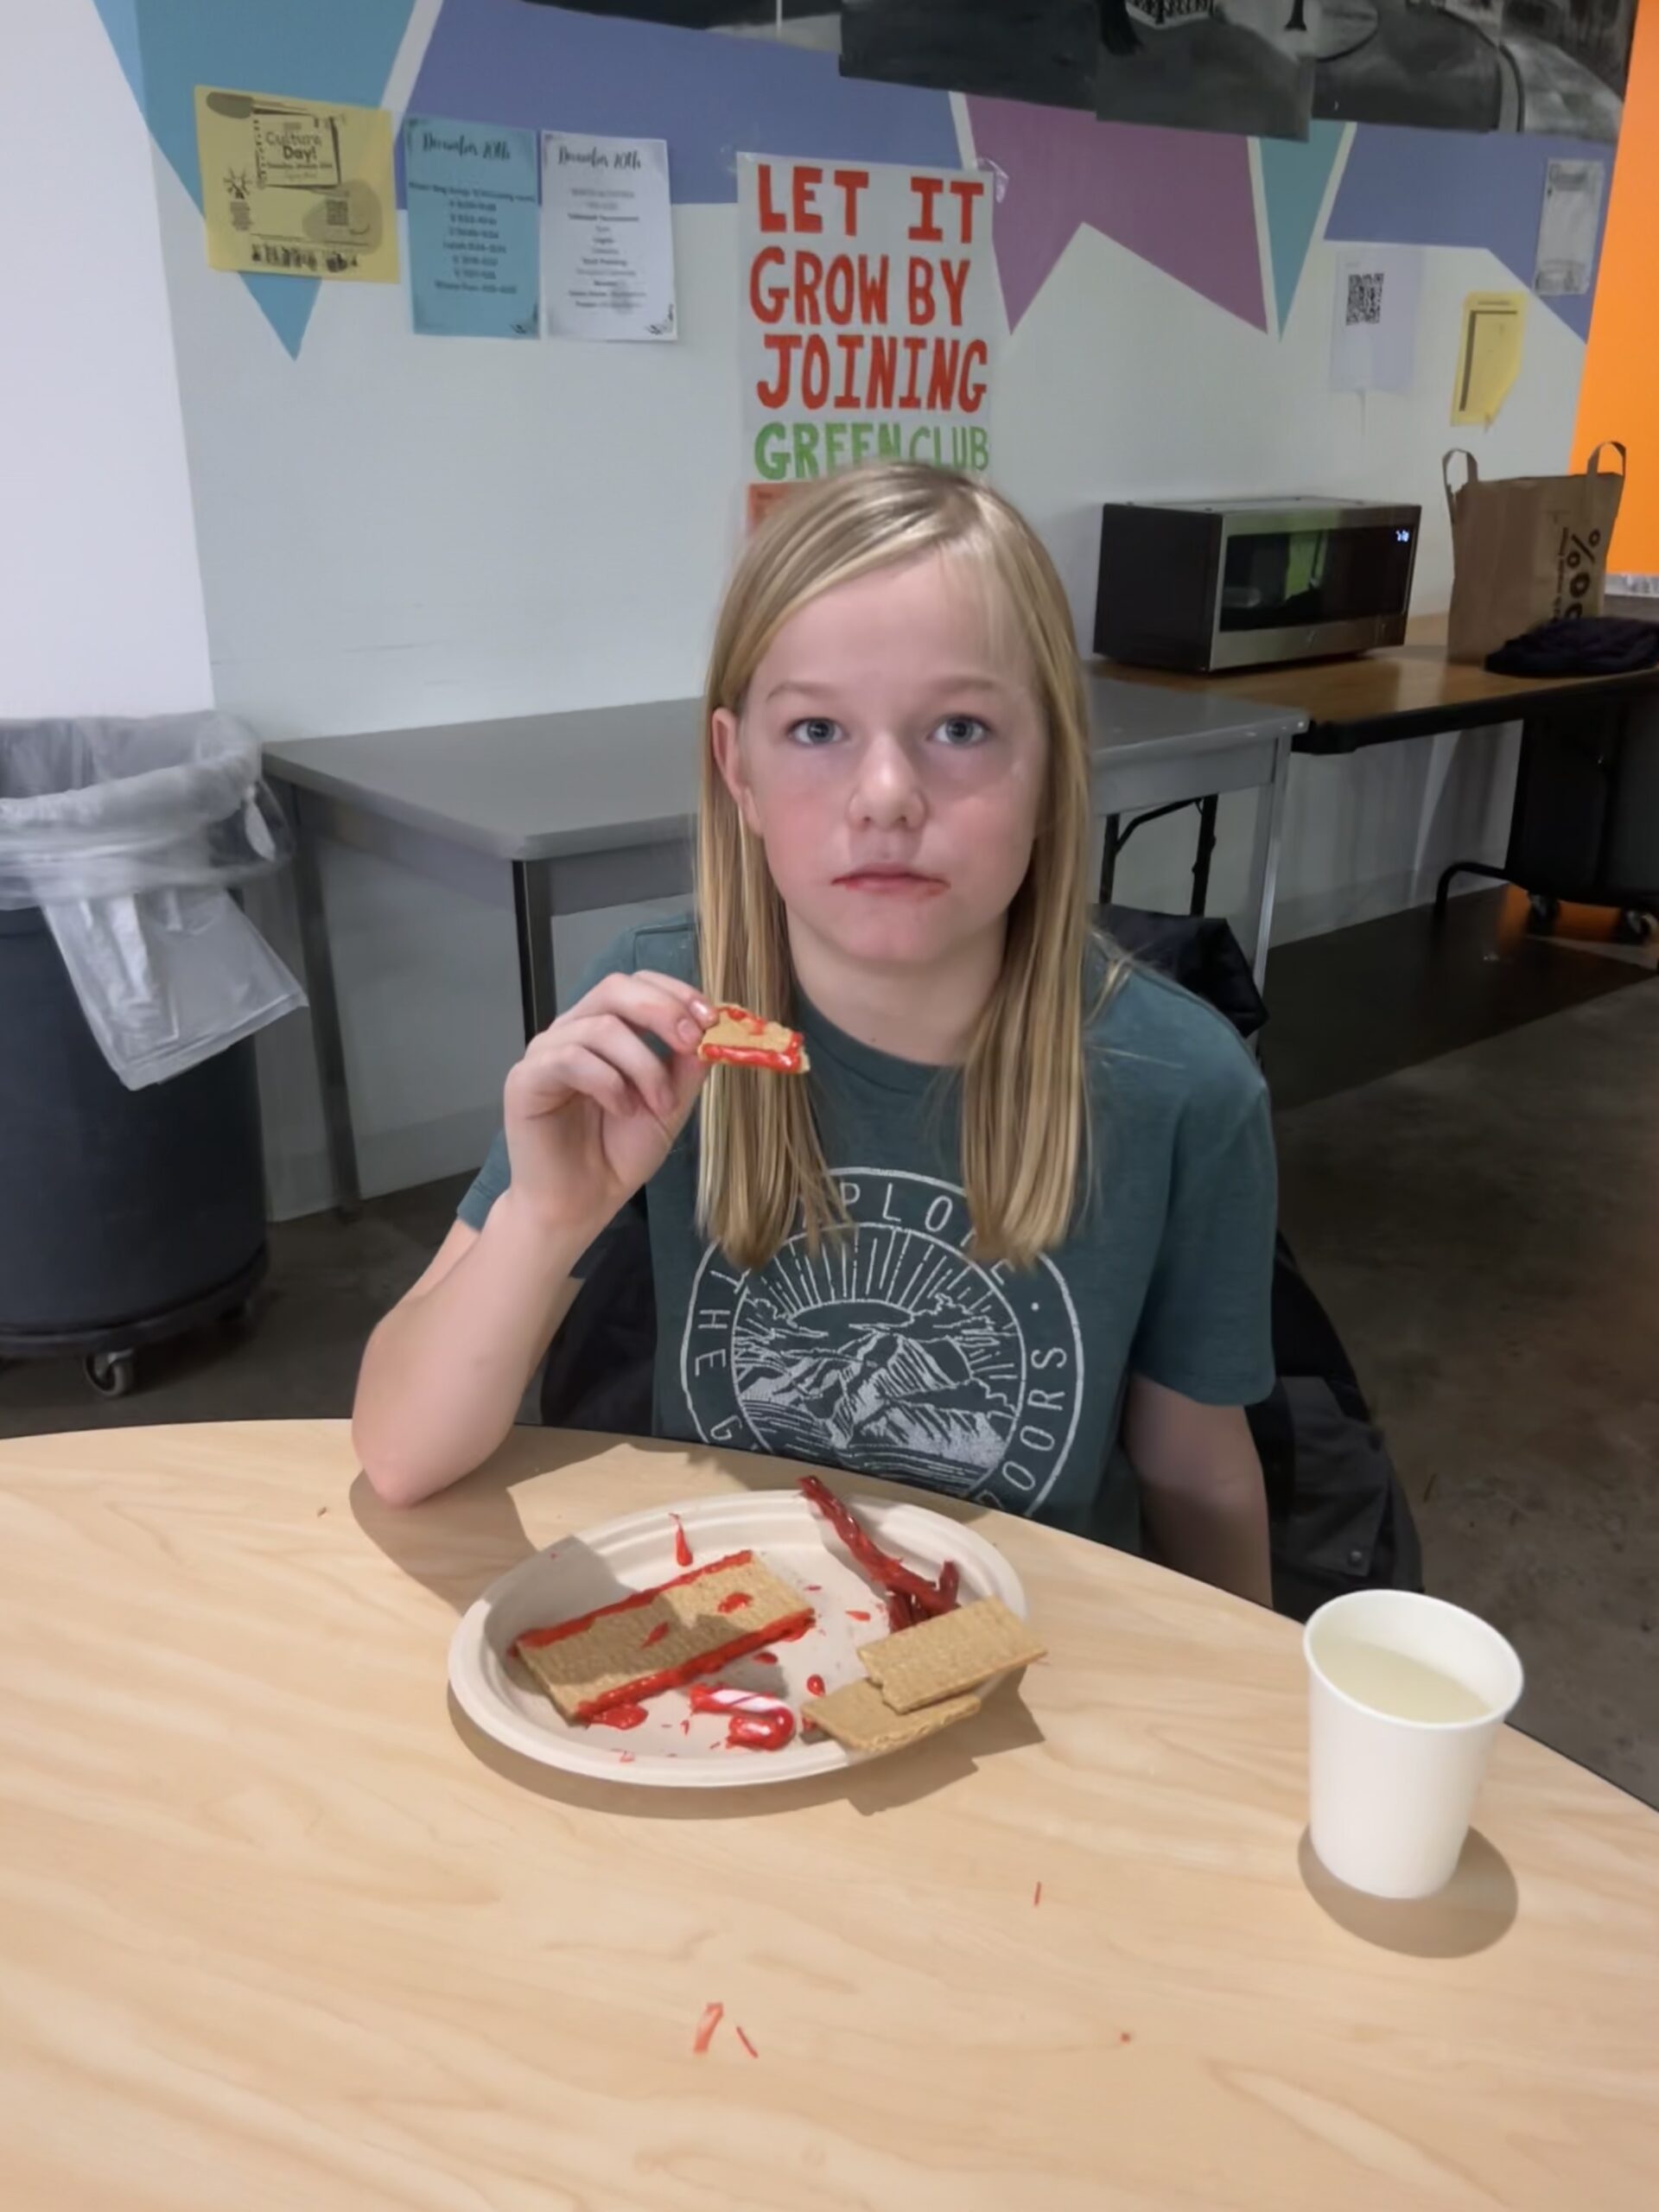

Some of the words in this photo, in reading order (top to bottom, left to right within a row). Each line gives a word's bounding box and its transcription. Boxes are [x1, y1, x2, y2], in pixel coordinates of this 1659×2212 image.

[265, 130, 321, 147] Culture
[283, 145, 317, 162] Day!
[558, 145, 608, 168] December
[757, 163, 869, 237] LET
[907, 175, 984, 244] IT
[749, 245, 889, 325] GROW
[907, 256, 970, 327] BY
[756, 334, 988, 413] JOINING
[753, 422, 901, 480] GREEN
[910, 425, 989, 472] CLUB
